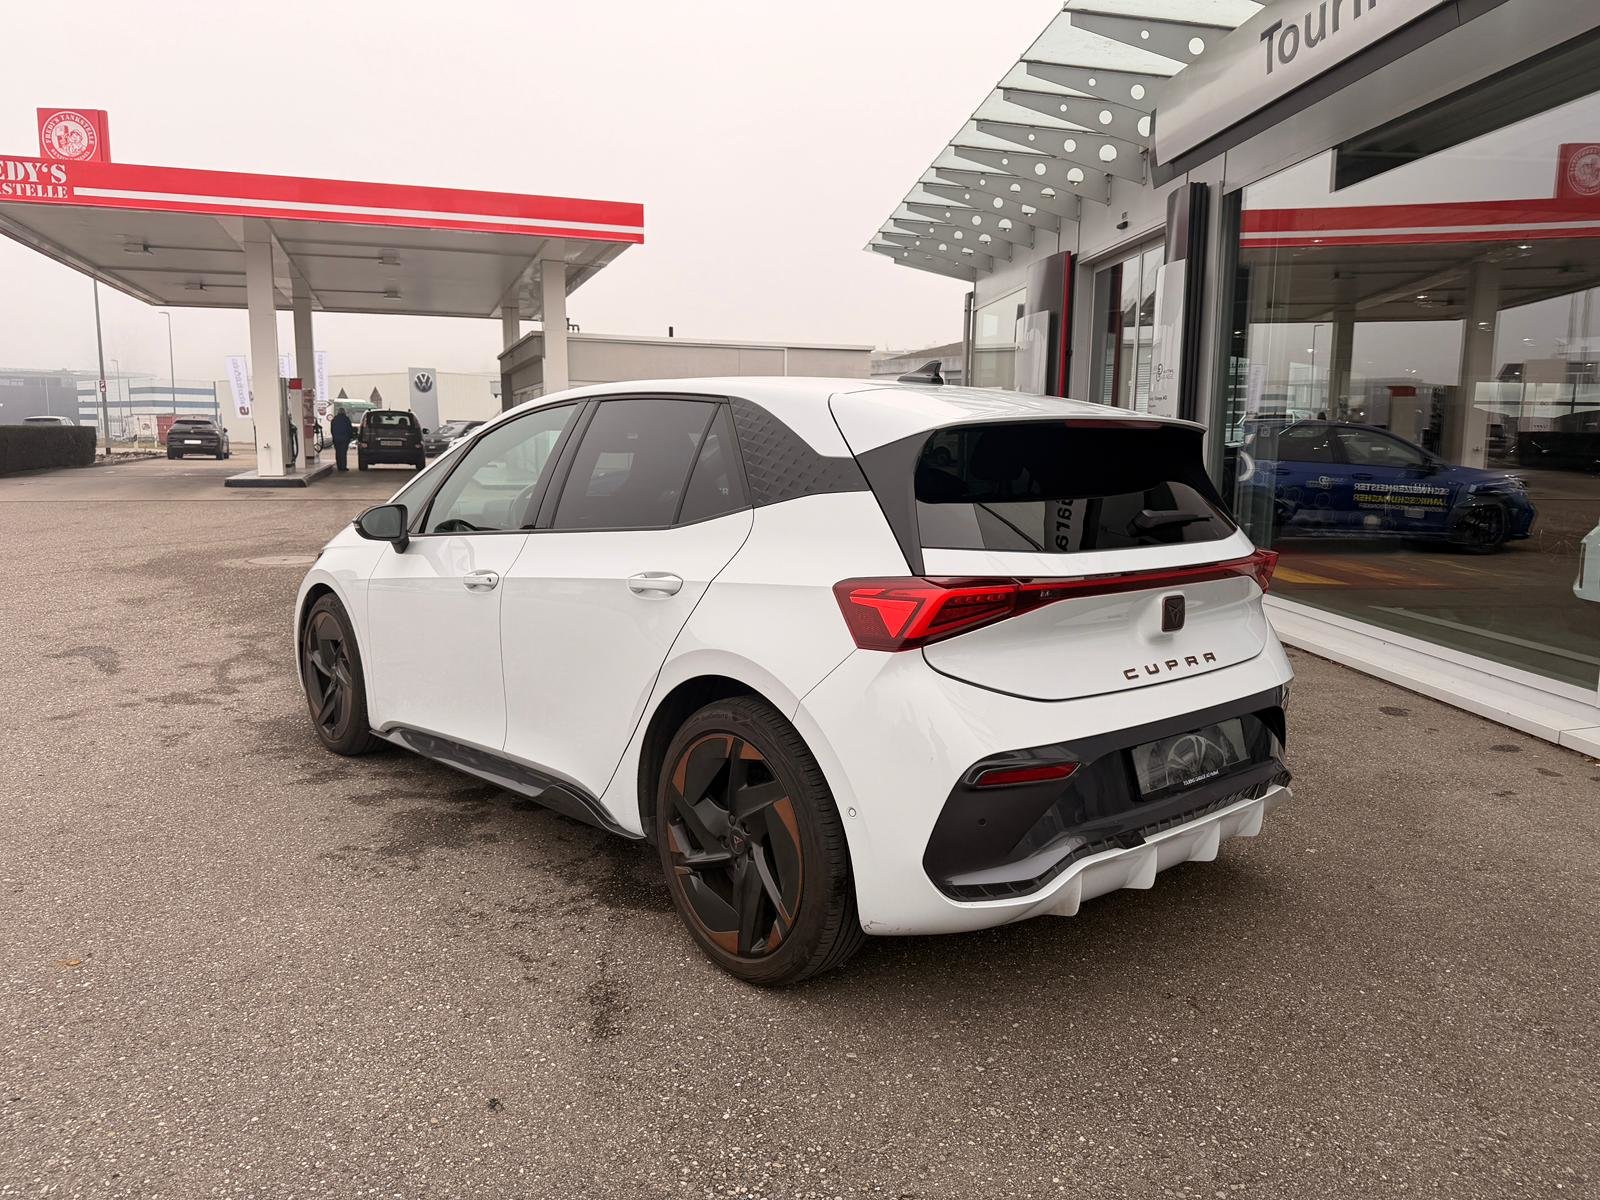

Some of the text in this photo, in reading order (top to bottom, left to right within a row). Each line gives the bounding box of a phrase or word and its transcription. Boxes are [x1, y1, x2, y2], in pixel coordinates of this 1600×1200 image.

[1260, 0, 1377, 75] Tour
[60, 114, 95, 145] TANKSTELLE
[0, 182, 68, 199] STELLE
[1123, 651, 1217, 681] CUPRA
